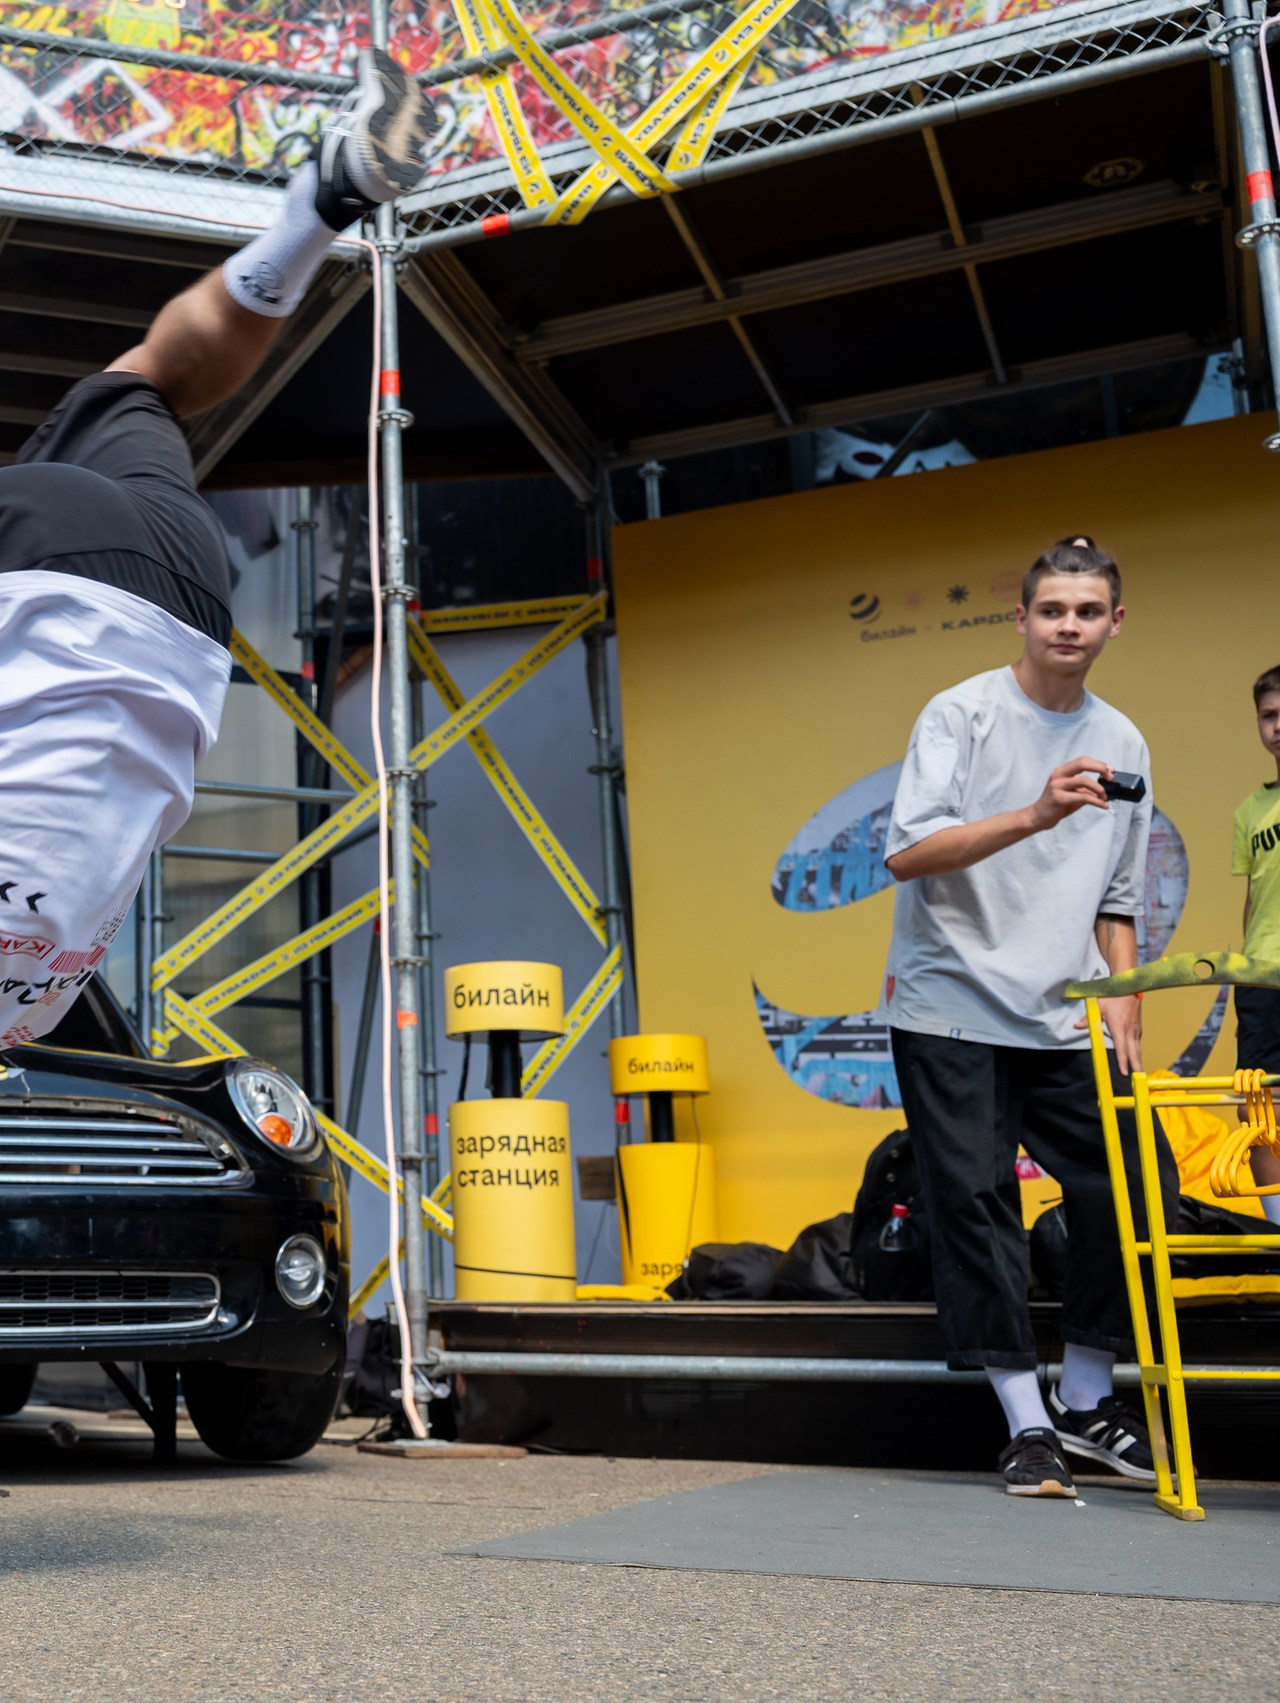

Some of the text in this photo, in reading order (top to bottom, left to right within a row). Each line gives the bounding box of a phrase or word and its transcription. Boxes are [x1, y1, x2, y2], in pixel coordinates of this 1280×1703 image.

[730, 23, 754, 48] ИЗ
[631, 65, 712, 144] УВАЖЕНИЯ
[689, 121, 707, 146] ИЗ
[518, 155, 533, 175] ИЗ
[454, 984, 550, 1009] билайн
[628, 1057, 695, 1075] билайн
[456, 1134, 567, 1160] зарядная
[458, 1168, 559, 1190] станция
